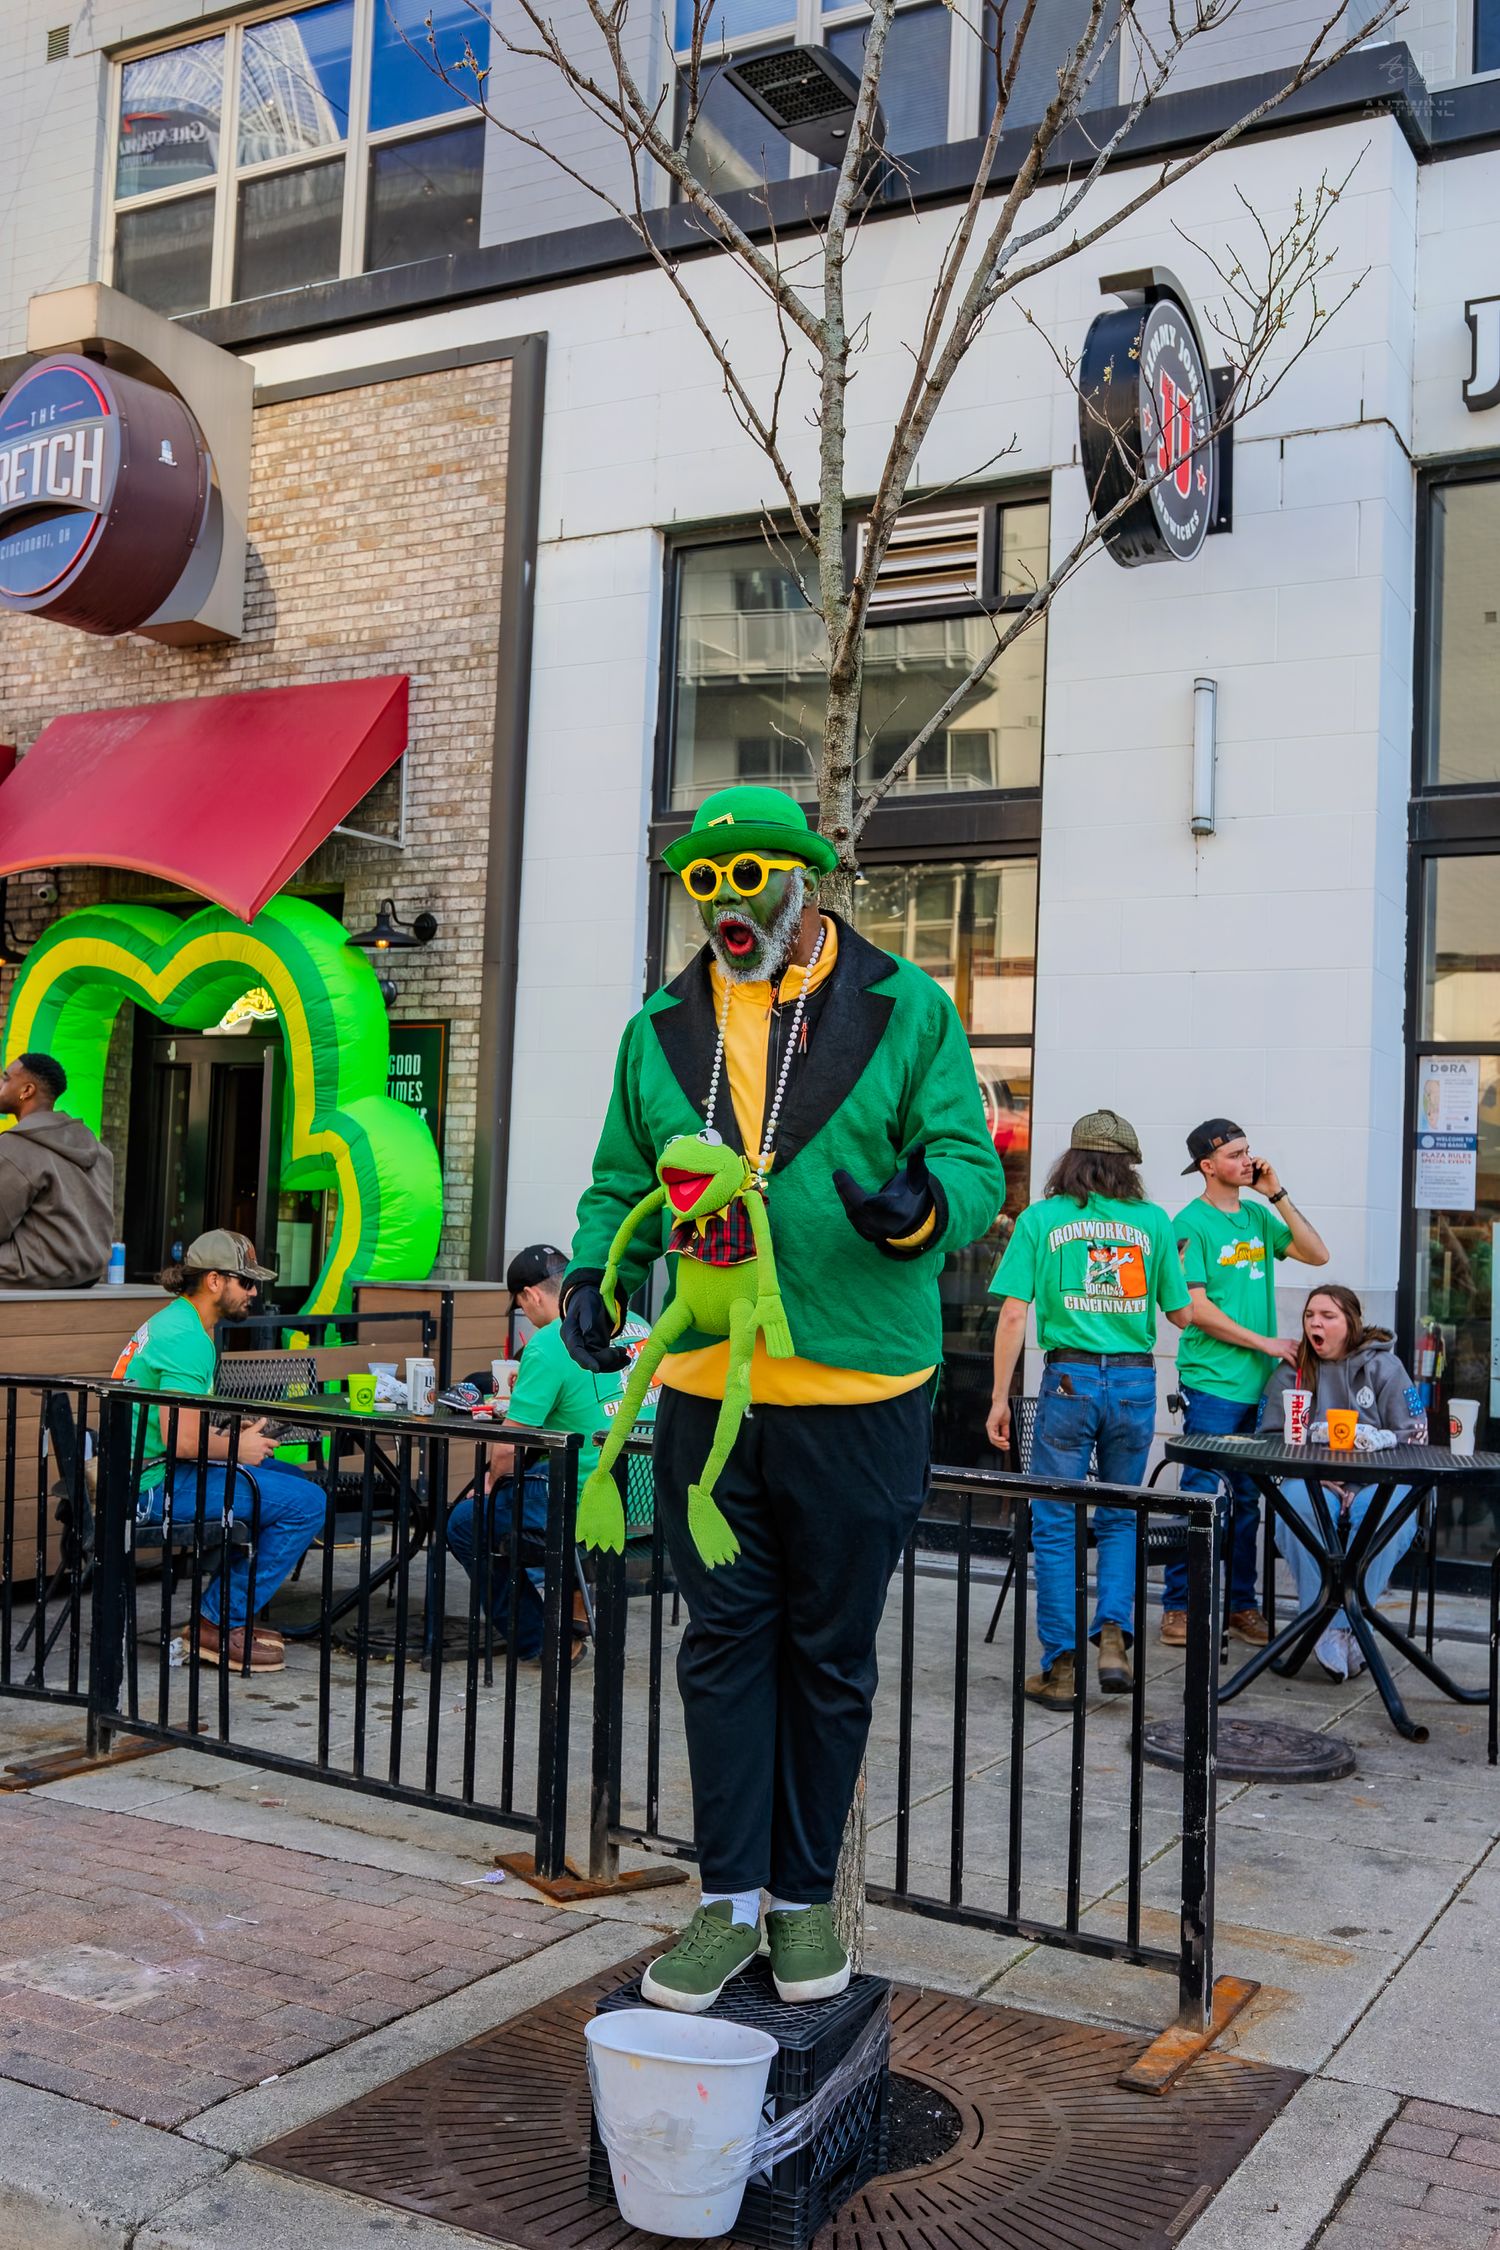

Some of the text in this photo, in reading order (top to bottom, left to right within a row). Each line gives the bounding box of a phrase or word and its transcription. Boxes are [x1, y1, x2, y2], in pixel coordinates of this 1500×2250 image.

[1144, 323, 1177, 390] JIMMY
[31, 404, 56, 427] THE
[58, 528, 71, 544] OH
[388, 1054, 421, 1076] GOOD
[1430, 1063, 1468, 1073] DORA
[1048, 1220, 1151, 1256] IRONWORKERS
[1085, 1282, 1112, 1297] LOCAL
[1063, 1296, 1147, 1314] CINCINNATI
